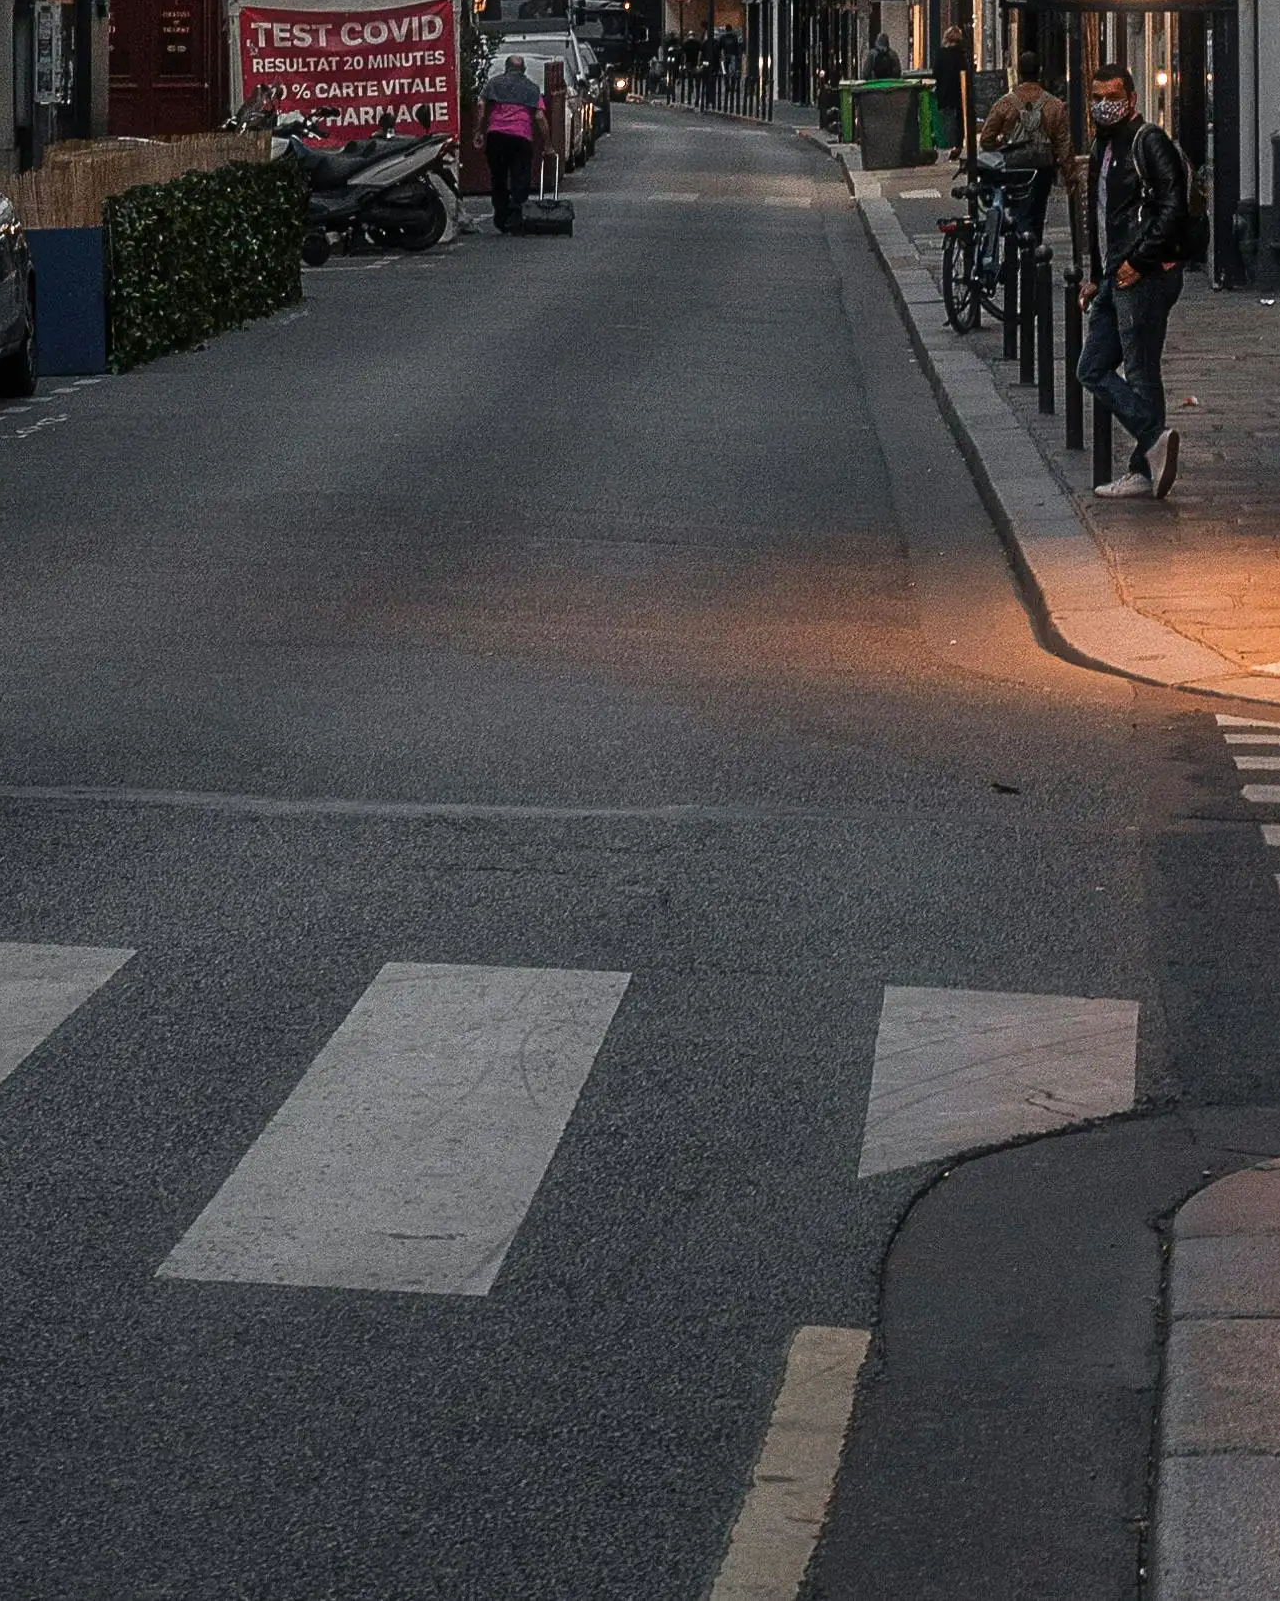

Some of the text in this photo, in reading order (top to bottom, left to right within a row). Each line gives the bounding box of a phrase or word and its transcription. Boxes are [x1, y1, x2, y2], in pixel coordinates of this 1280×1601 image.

[250, 14, 444, 49] TEST COVID
[252, 49, 446, 74] RESULTAT 20 MINUTES
[315, 80, 379, 98] CARTE
[381, 76, 448, 96] VITALE
